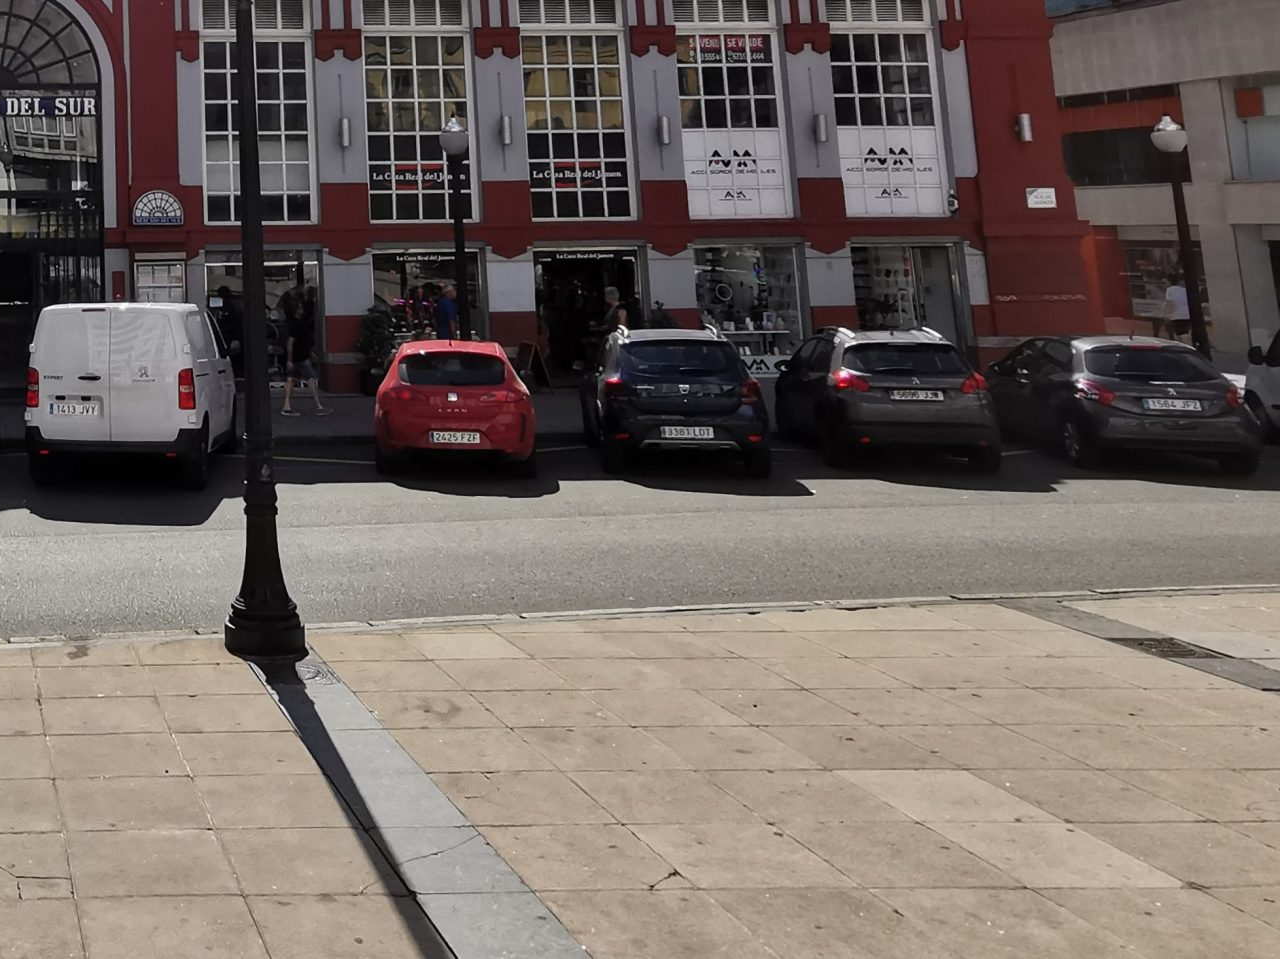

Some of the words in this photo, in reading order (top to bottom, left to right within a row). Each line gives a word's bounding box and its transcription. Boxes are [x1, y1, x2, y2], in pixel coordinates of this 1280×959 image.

[6, 97, 45, 116] DEL
[54, 97, 97, 116] SUR
[372, 172, 383, 180] La
[384, 172, 404, 180] Csa
[424, 172, 437, 180] del
[582, 170, 596, 178] del
[57, 404, 76, 414] 1413
[79, 405, 97, 415] JVY
[435, 432, 458, 442] 2425
